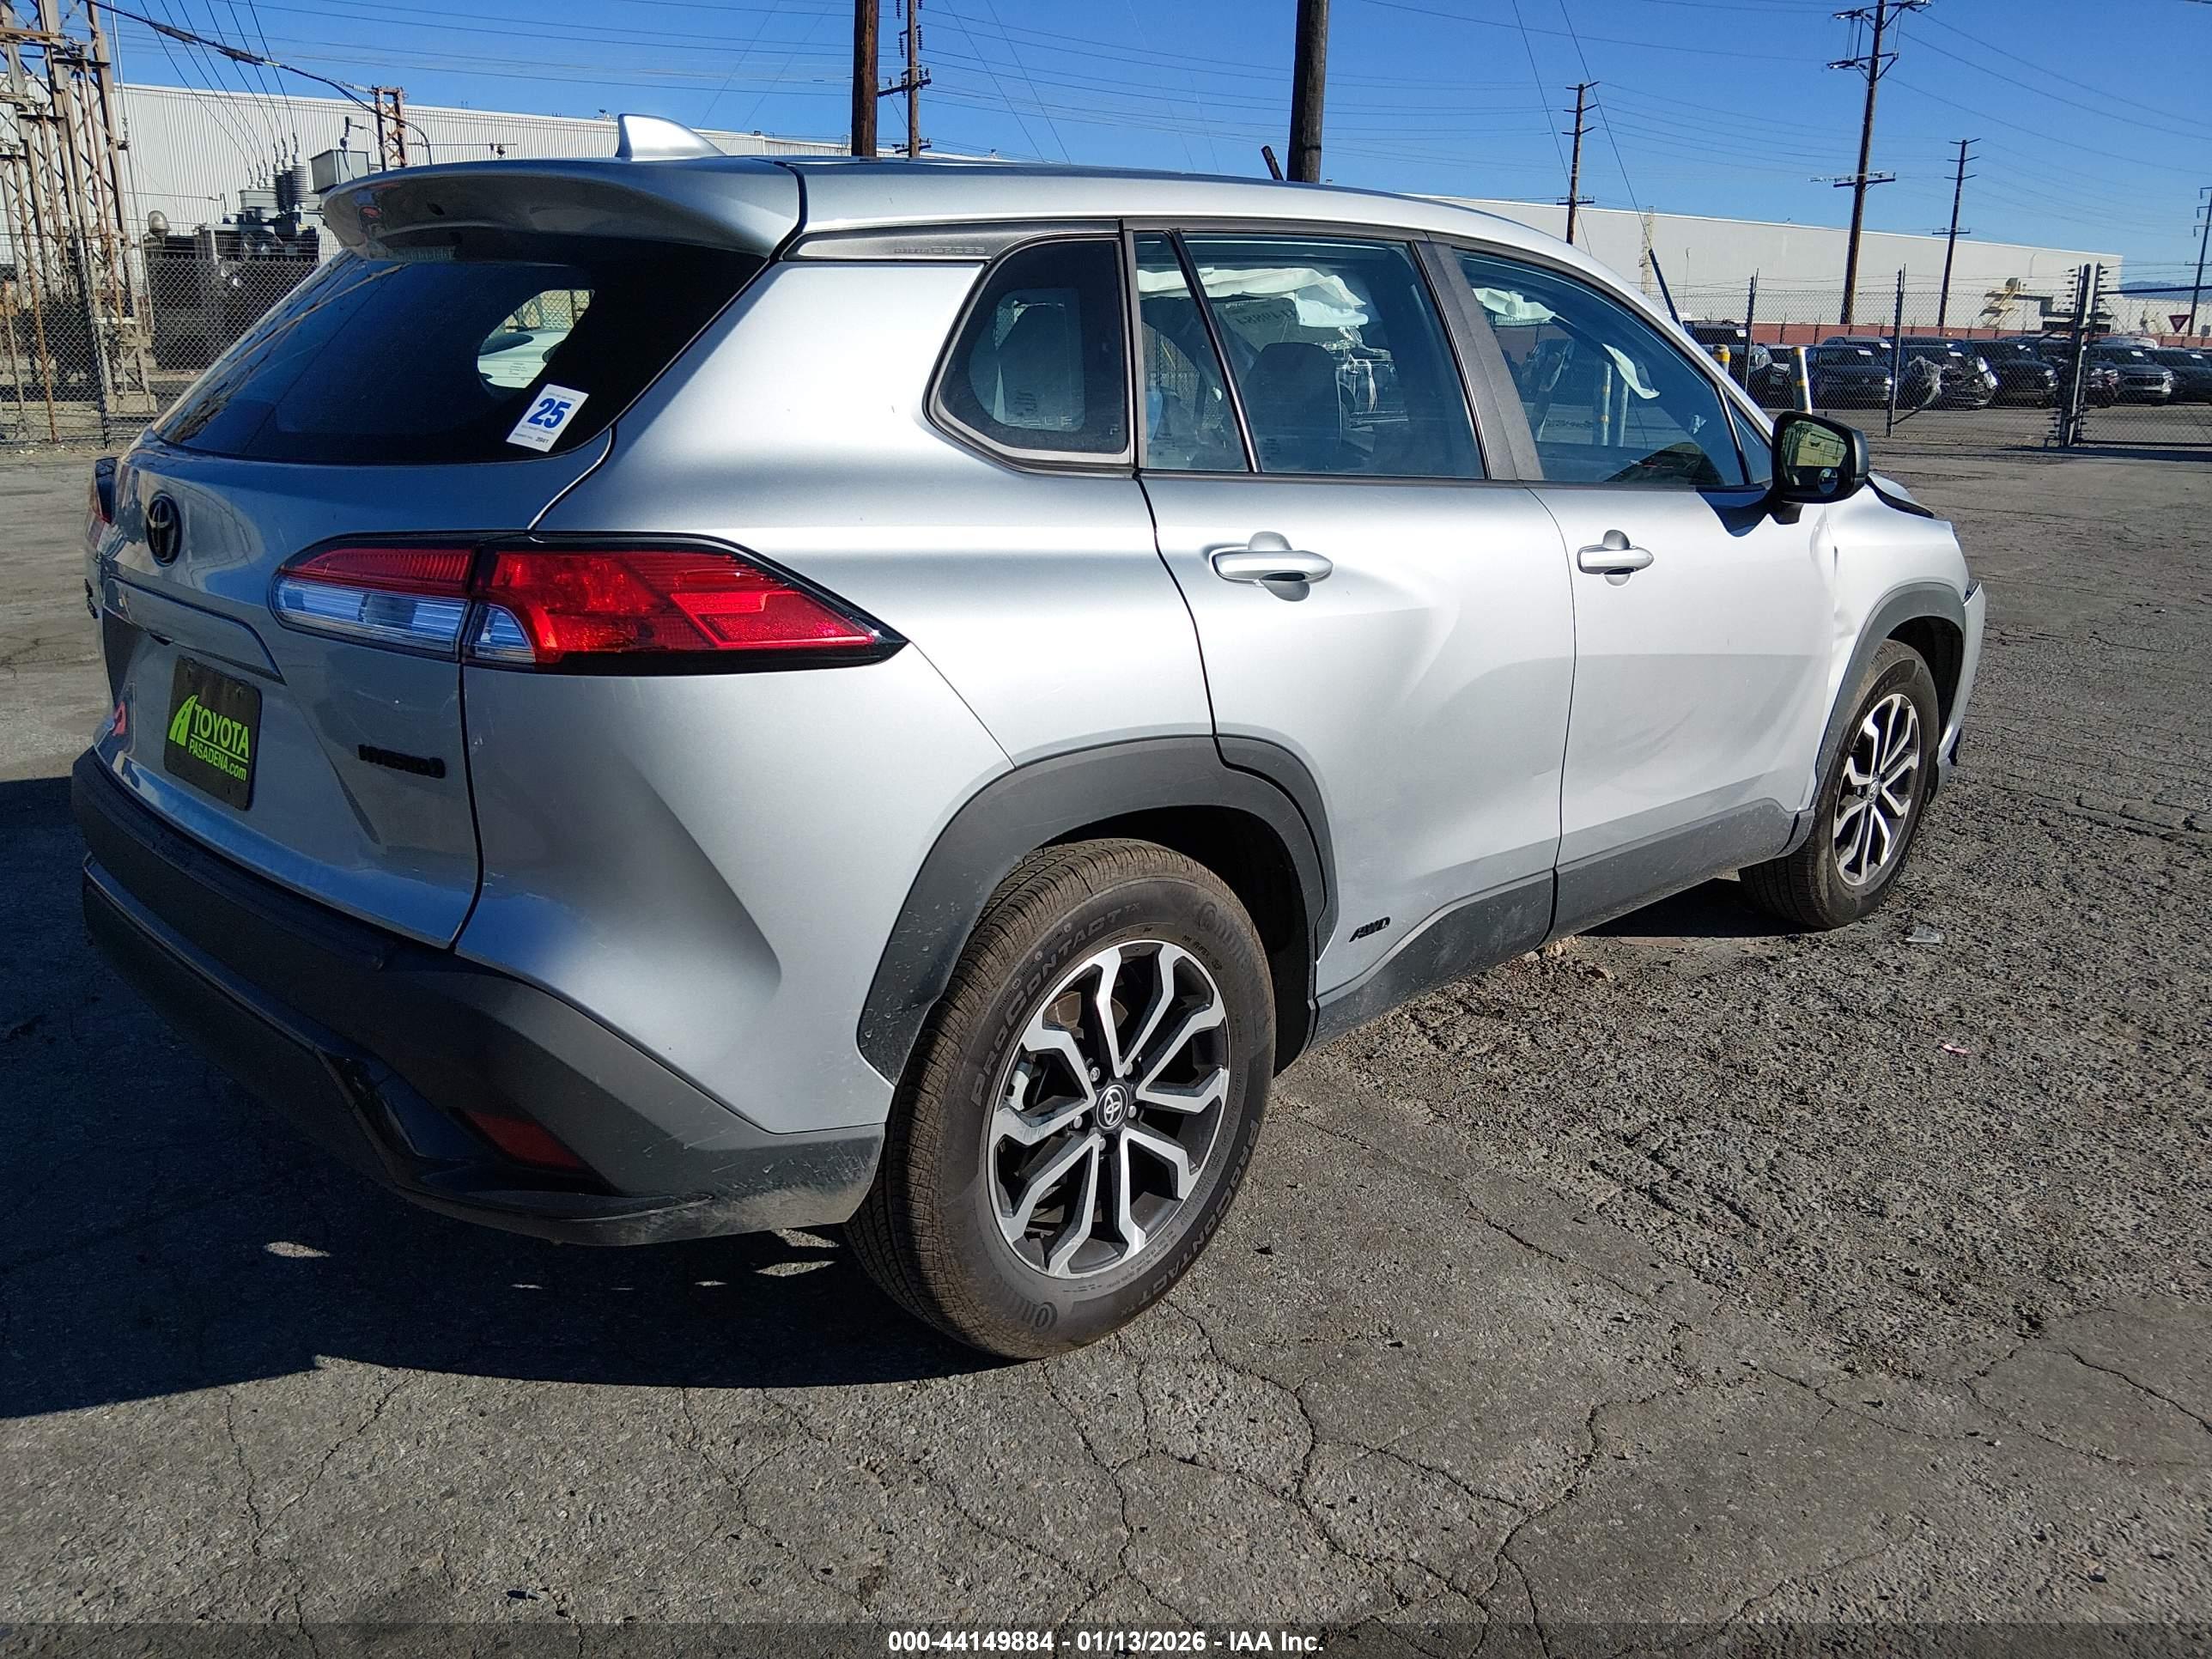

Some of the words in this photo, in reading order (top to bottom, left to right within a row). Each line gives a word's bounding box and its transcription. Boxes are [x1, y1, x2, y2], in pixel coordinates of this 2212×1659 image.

[527, 398, 572, 428] 25
[193, 702, 249, 759] TOYOTA
[187, 738, 247, 781] PASADENA.com
